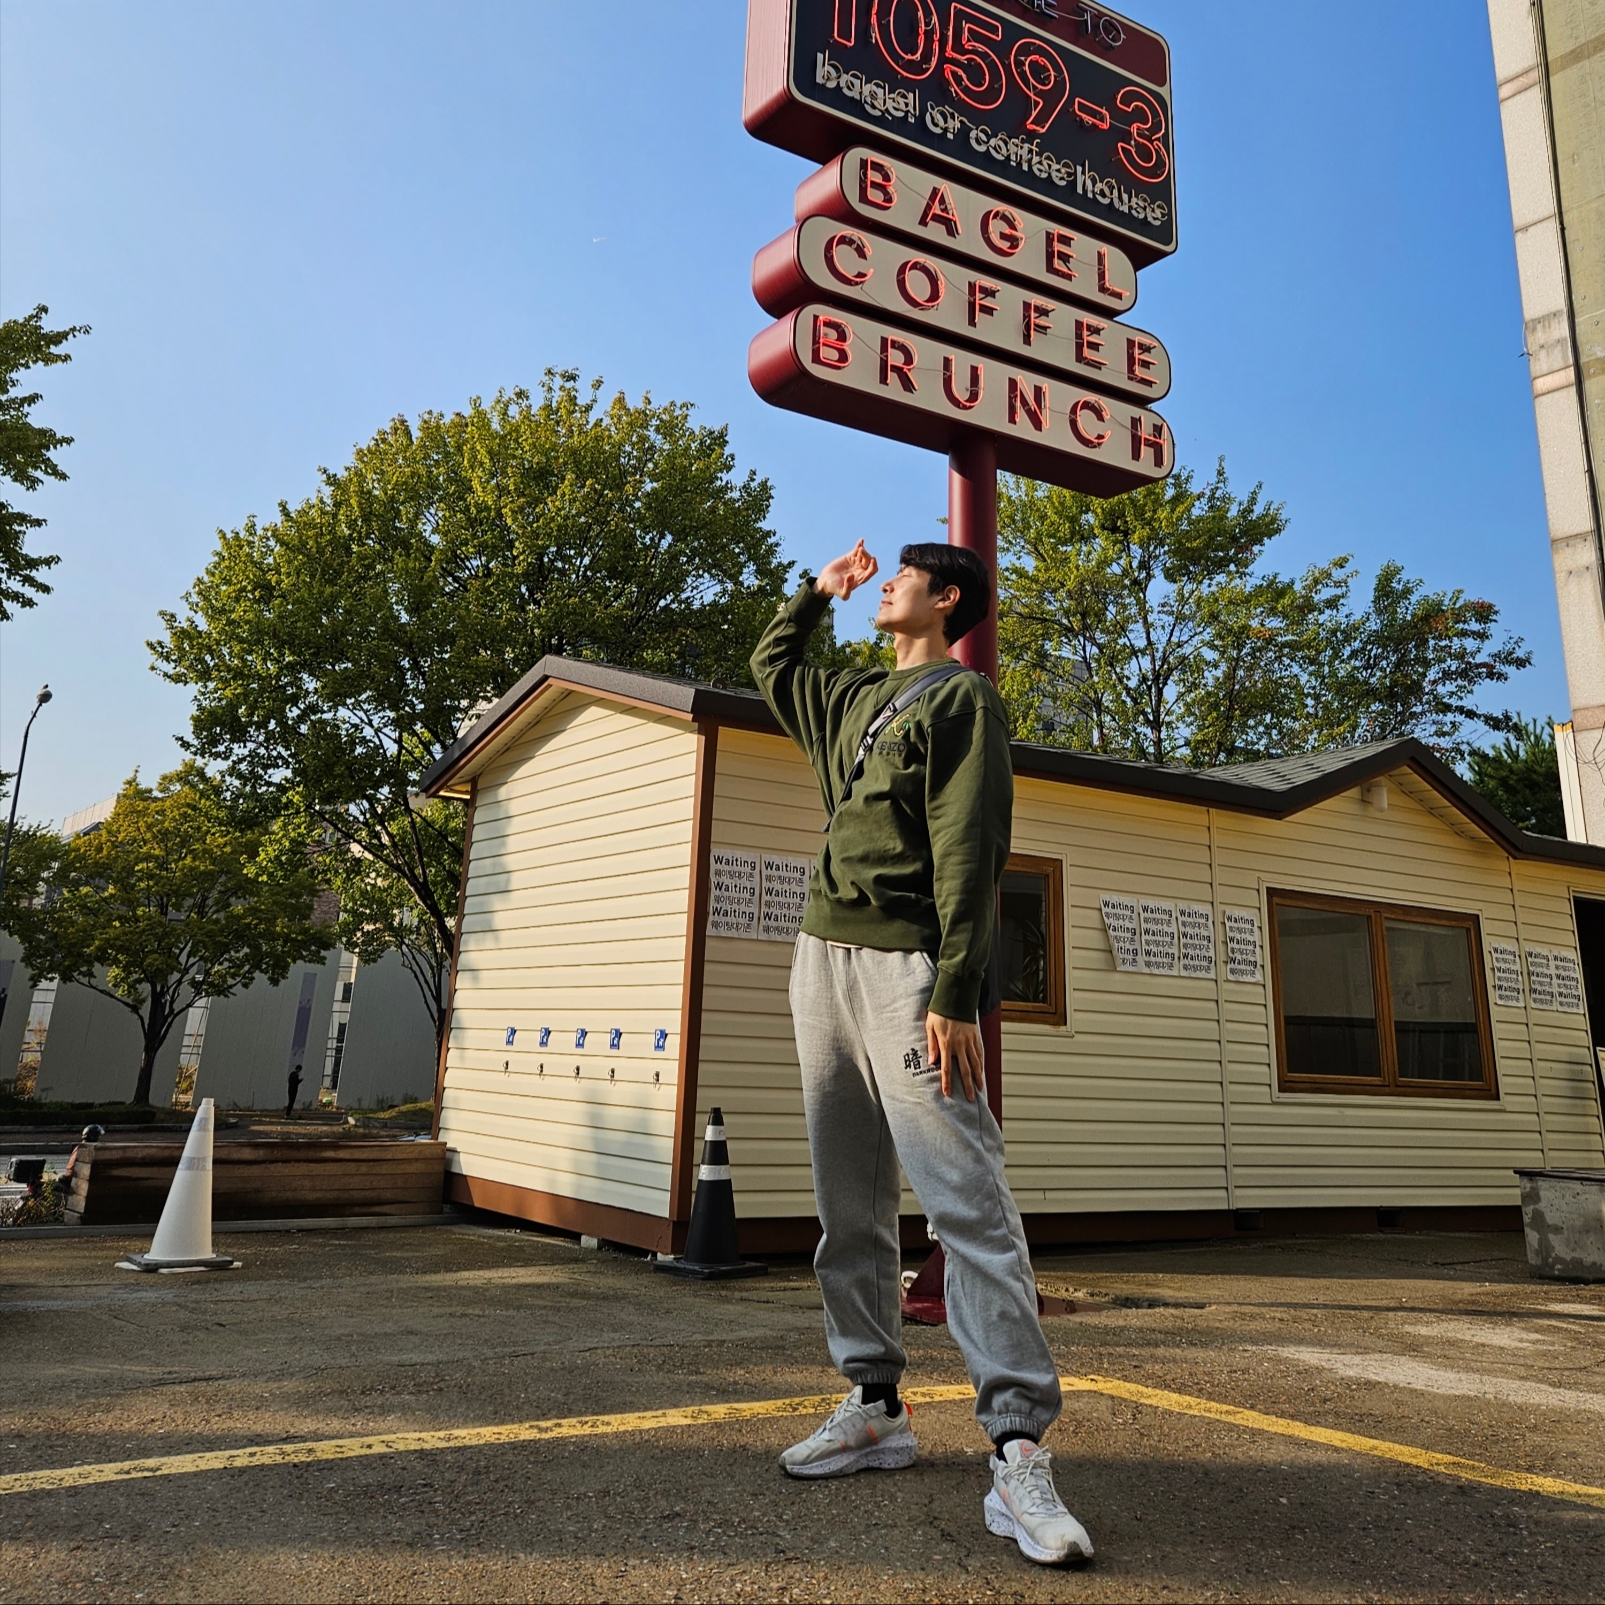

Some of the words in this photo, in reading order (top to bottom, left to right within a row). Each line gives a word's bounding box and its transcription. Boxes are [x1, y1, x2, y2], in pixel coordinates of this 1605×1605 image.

[1074, 3, 1123, 48] TO
[834, 0, 1169, 182] 1059-3
[816, 50, 919, 123] bagel
[969, 125, 1075, 186] coffee
[1076, 159, 1169, 226] house
[859, 156, 1129, 301] BAGEL
[823, 230, 1160, 387] COFFEE
[811, 315, 1167, 469] BRUNCH
[713, 855, 756, 871] Waiting
[764, 861, 805, 876] Waiting
[713, 881, 756, 897] Waiting
[764, 887, 805, 902] Waiting
[1102, 899, 1134, 914] Waiting
[1141, 904, 1173, 918] Waiting
[712, 906, 755, 922] Waiting
[763, 911, 804, 926] Waiting
[1179, 909, 1209, 922] Waiting
[1226, 914, 1255, 927] Waiting
[1143, 927, 1175, 940] Waiting
[1181, 931, 1211, 944] Waiting
[1228, 935, 1257, 949] Waiting
[1117, 945, 1138, 957] iting
[1144, 948, 1175, 961] Waiting
[1492, 946, 1517, 958] Waiting
[1526, 951, 1550, 962] Waiting
[1182, 952, 1212, 964] Waiting
[1229, 956, 1258, 969] Waiting
[1552, 954, 1576, 966] Waiting
[1495, 965, 1519, 977] Waiting
[1555, 973, 1580, 984] Waiting
[1497, 984, 1520, 995] Waiting
[1531, 987, 1554, 998] Waiting
[1557, 990, 1581, 1002] Waiting
[903, 1047, 923, 1070] 暗
